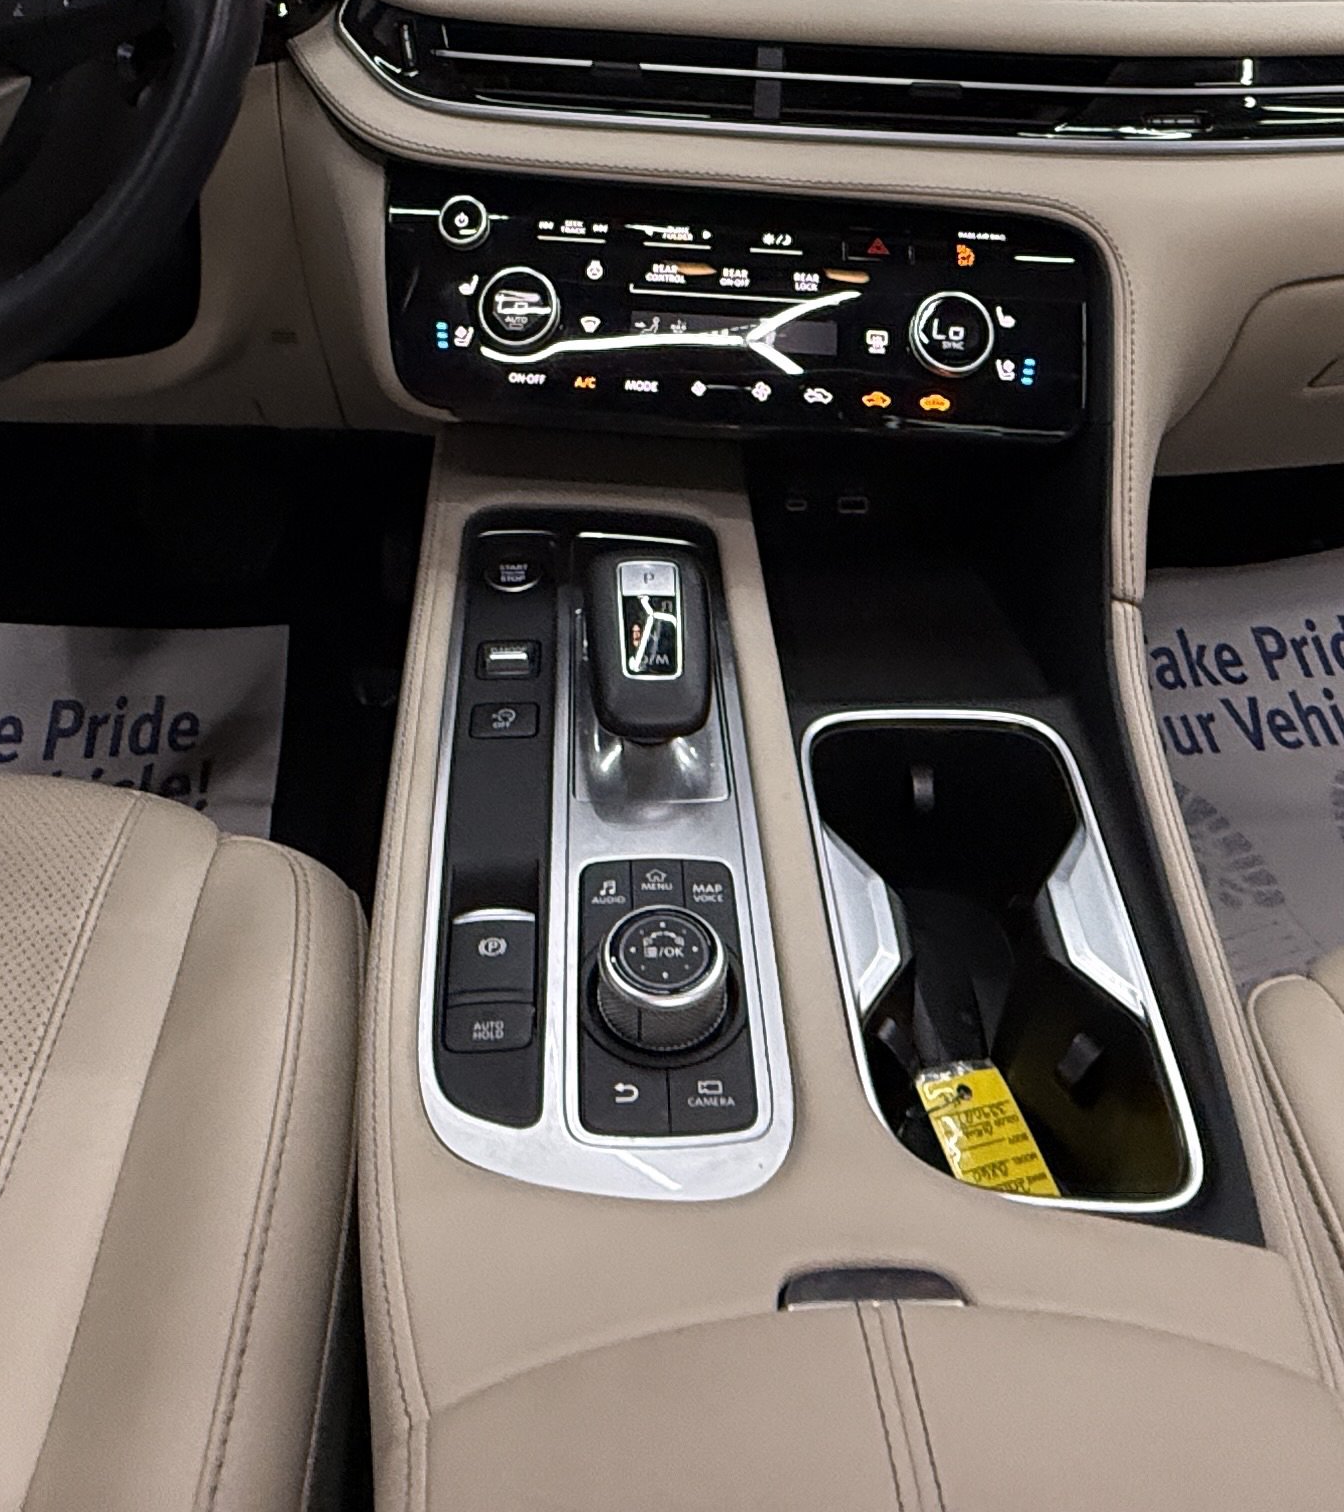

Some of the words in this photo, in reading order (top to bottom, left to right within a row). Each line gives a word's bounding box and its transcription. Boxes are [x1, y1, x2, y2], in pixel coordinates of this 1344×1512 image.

[653, 264, 679, 273] REAR
[722, 267, 748, 278] REAR
[645, 273, 686, 284] CONTROL
[793, 272, 819, 283] REAR
[795, 282, 818, 291] LOCK
[504, 316, 528, 324] AUTO
[932, 318, 964, 340] Lo
[574, 376, 596, 388] A/C
[625, 380, 658, 392] MODE
[643, 572, 655, 584] P
[1144, 628, 1249, 691] ake
[43, 694, 200, 763] Pride
[641, 882, 673, 891] MENU
[692, 883, 723, 893] MAP
[591, 895, 626, 905] AUDIO
[692, 892, 724, 903] VOICE
[473, 1021, 505, 1031] AUTO
[472, 1030, 505, 1041] HOLD
[687, 1096, 736, 1108] CAMERA
